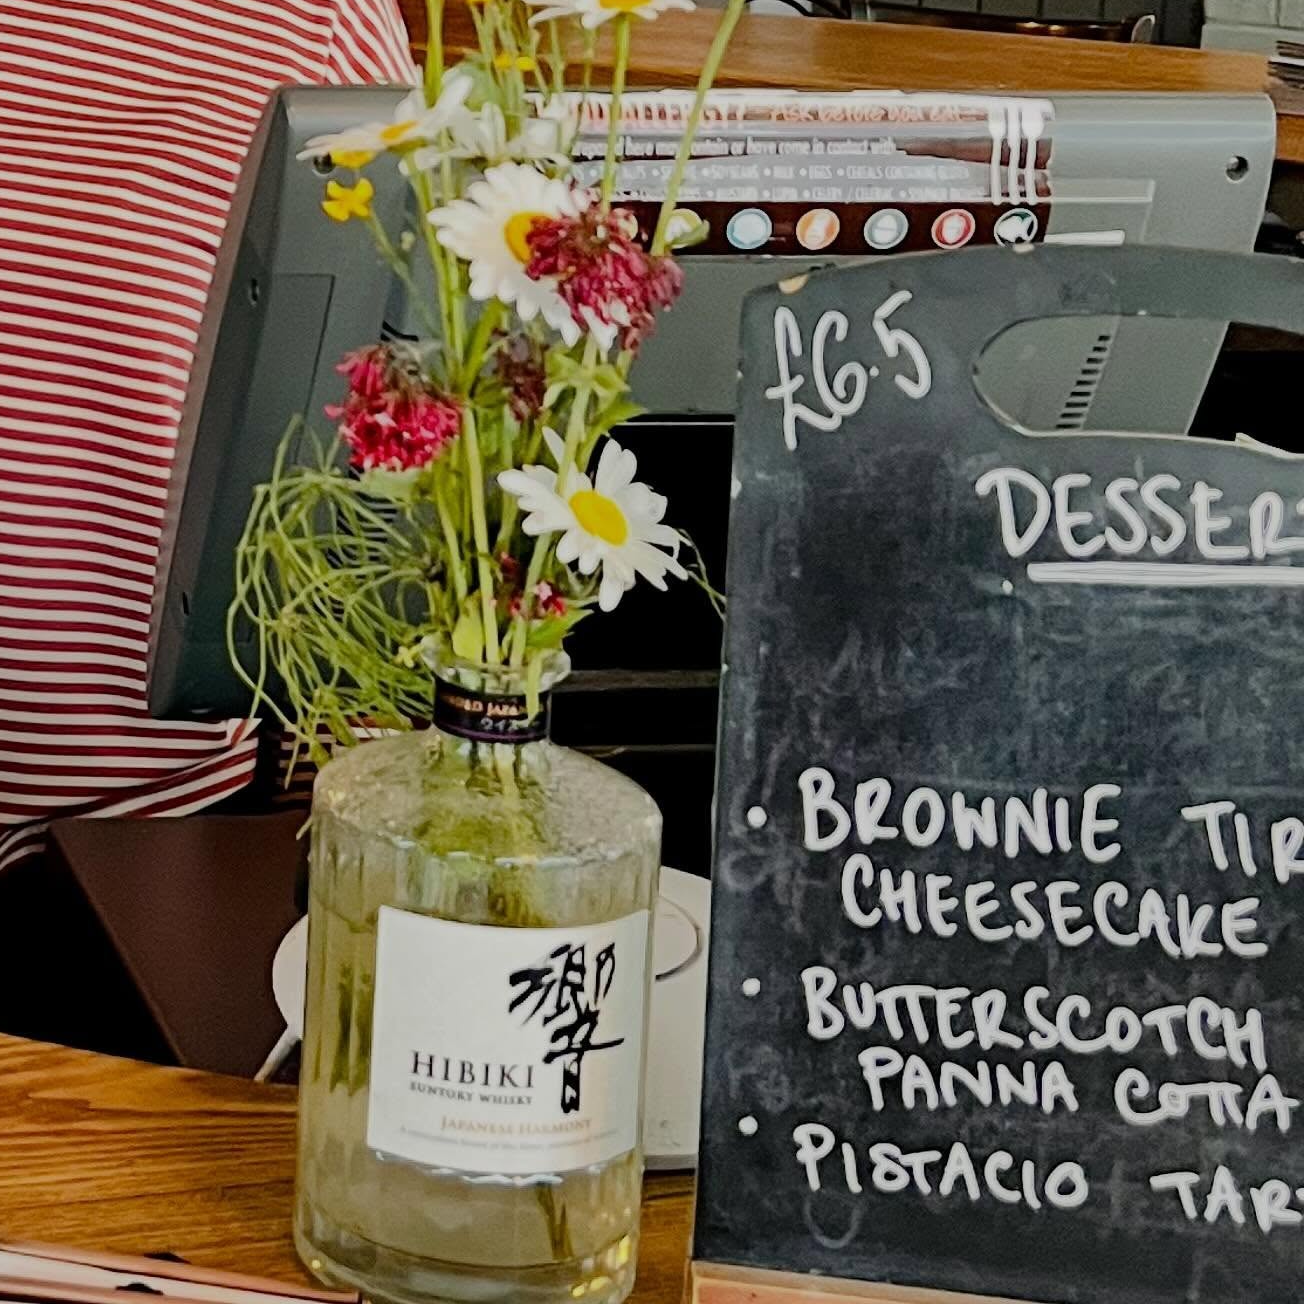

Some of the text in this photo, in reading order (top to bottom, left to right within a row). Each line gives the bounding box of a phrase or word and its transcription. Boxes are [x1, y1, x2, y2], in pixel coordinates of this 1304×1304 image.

[765, 289, 932, 450] £6.5
[975, 467, 1304, 560] DESSER
[798, 766, 1122, 864] BROWNIE
[840, 852, 1269, 960] CHEESECAKE
[800, 965, 1268, 1073] BUTTERSCOTCH
[409, 1080, 534, 1106] SUNTORY WHISKY
[410, 1050, 535, 1089] HIBIKI
[857, 1046, 1079, 1114] PANNA
[792, 1123, 1304, 1233] PISTACIO TAR
